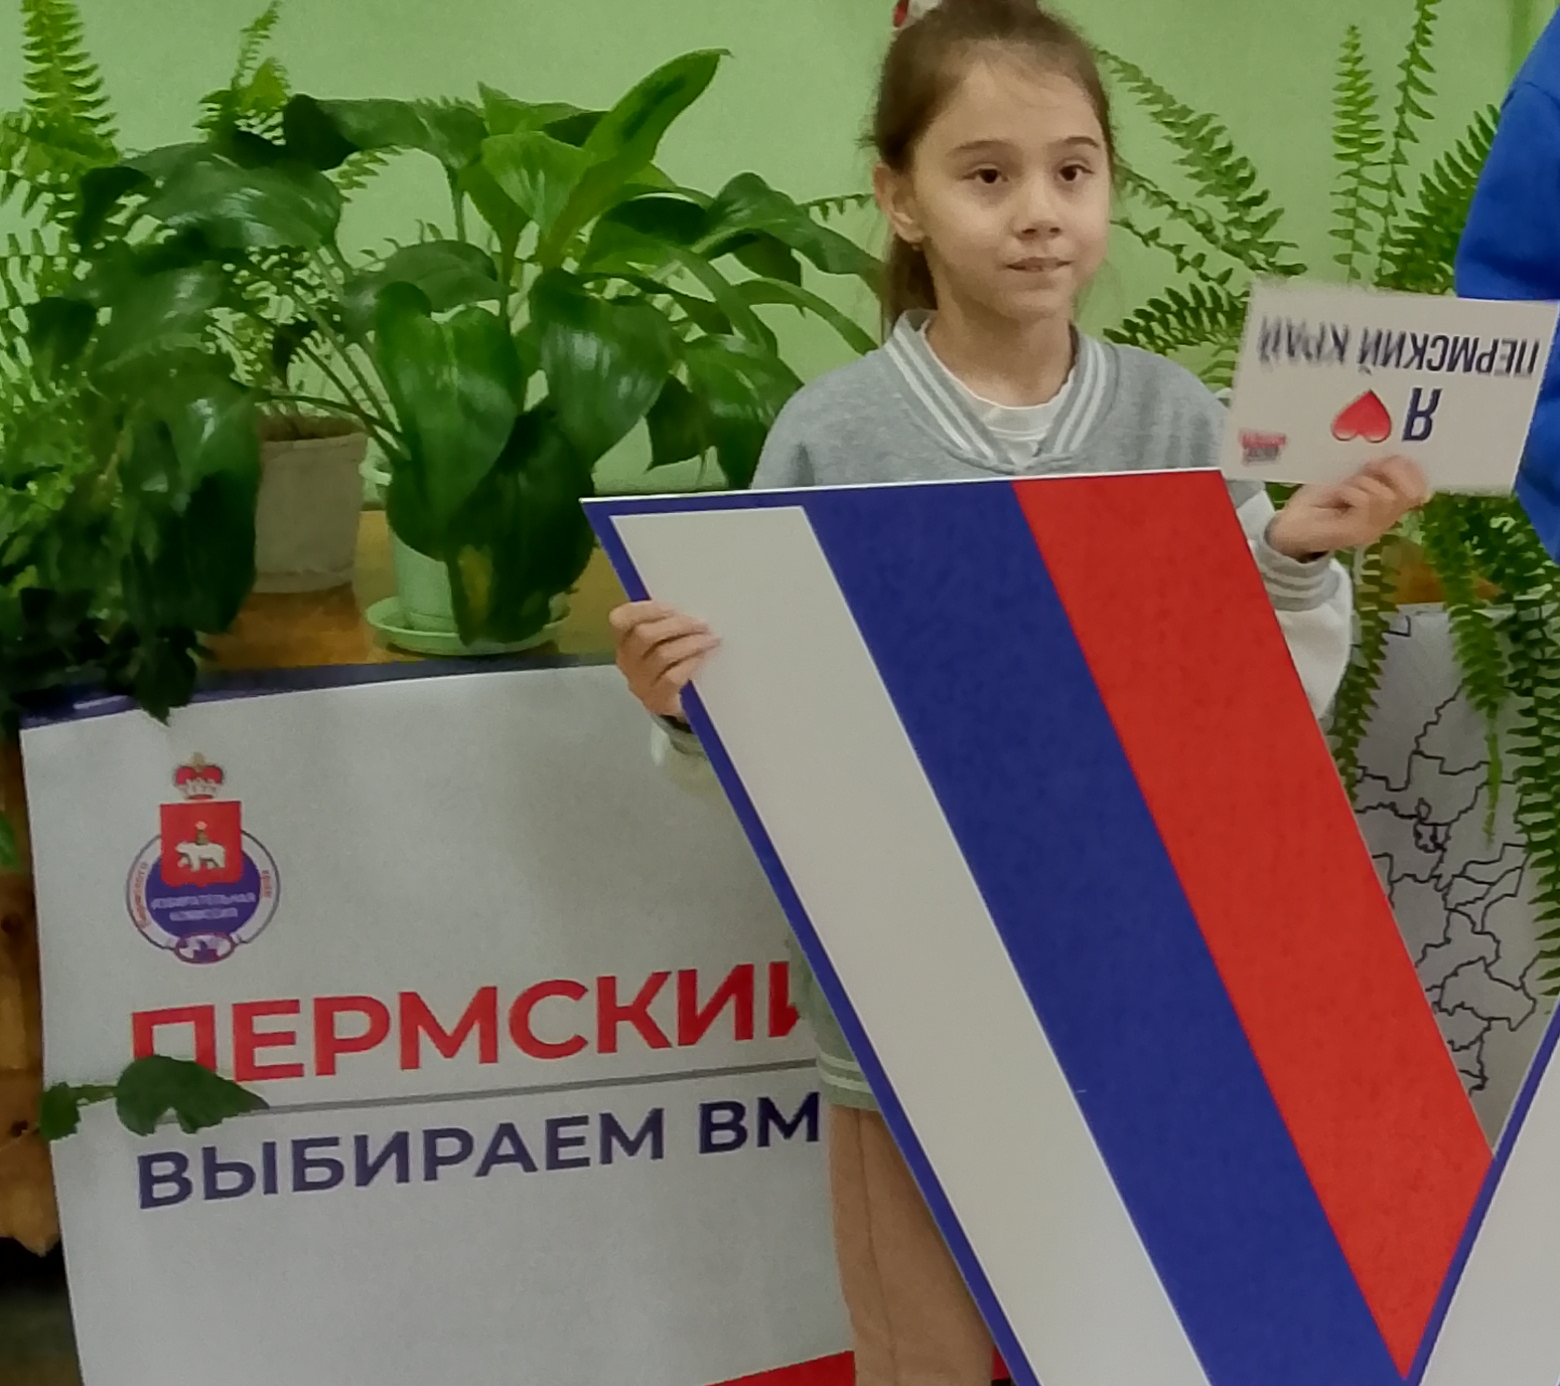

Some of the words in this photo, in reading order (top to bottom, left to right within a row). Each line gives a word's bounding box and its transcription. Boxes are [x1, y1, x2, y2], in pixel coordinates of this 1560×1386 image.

[1357, 326, 1541, 379] ПЕРМСКИЙ
[1402, 387, 1442, 442] Я
[136, 1107, 666, 1209] ВЫБИРАЕМ
